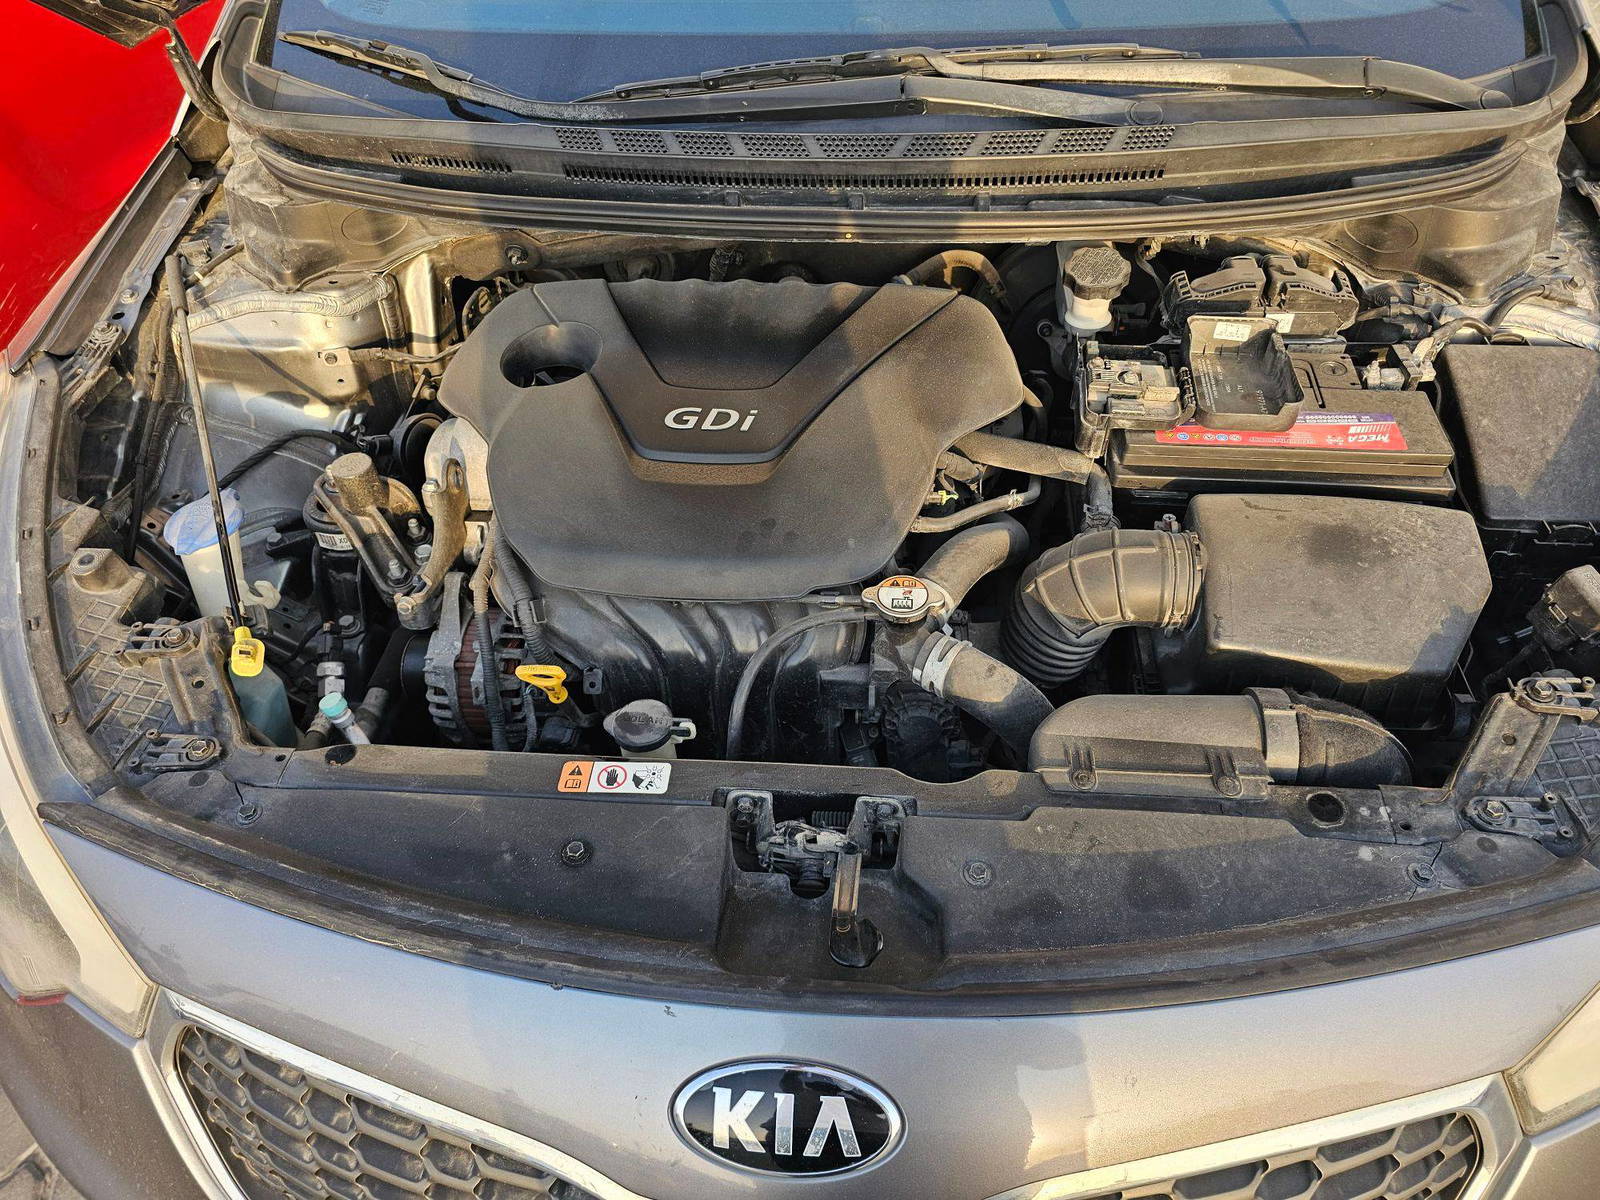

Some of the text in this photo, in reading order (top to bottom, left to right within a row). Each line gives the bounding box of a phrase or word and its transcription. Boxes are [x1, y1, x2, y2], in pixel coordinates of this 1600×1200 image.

[664, 406, 759, 432] GDi
[1346, 433, 1390, 443] MEGA
[713, 1087, 862, 1157] KIA
